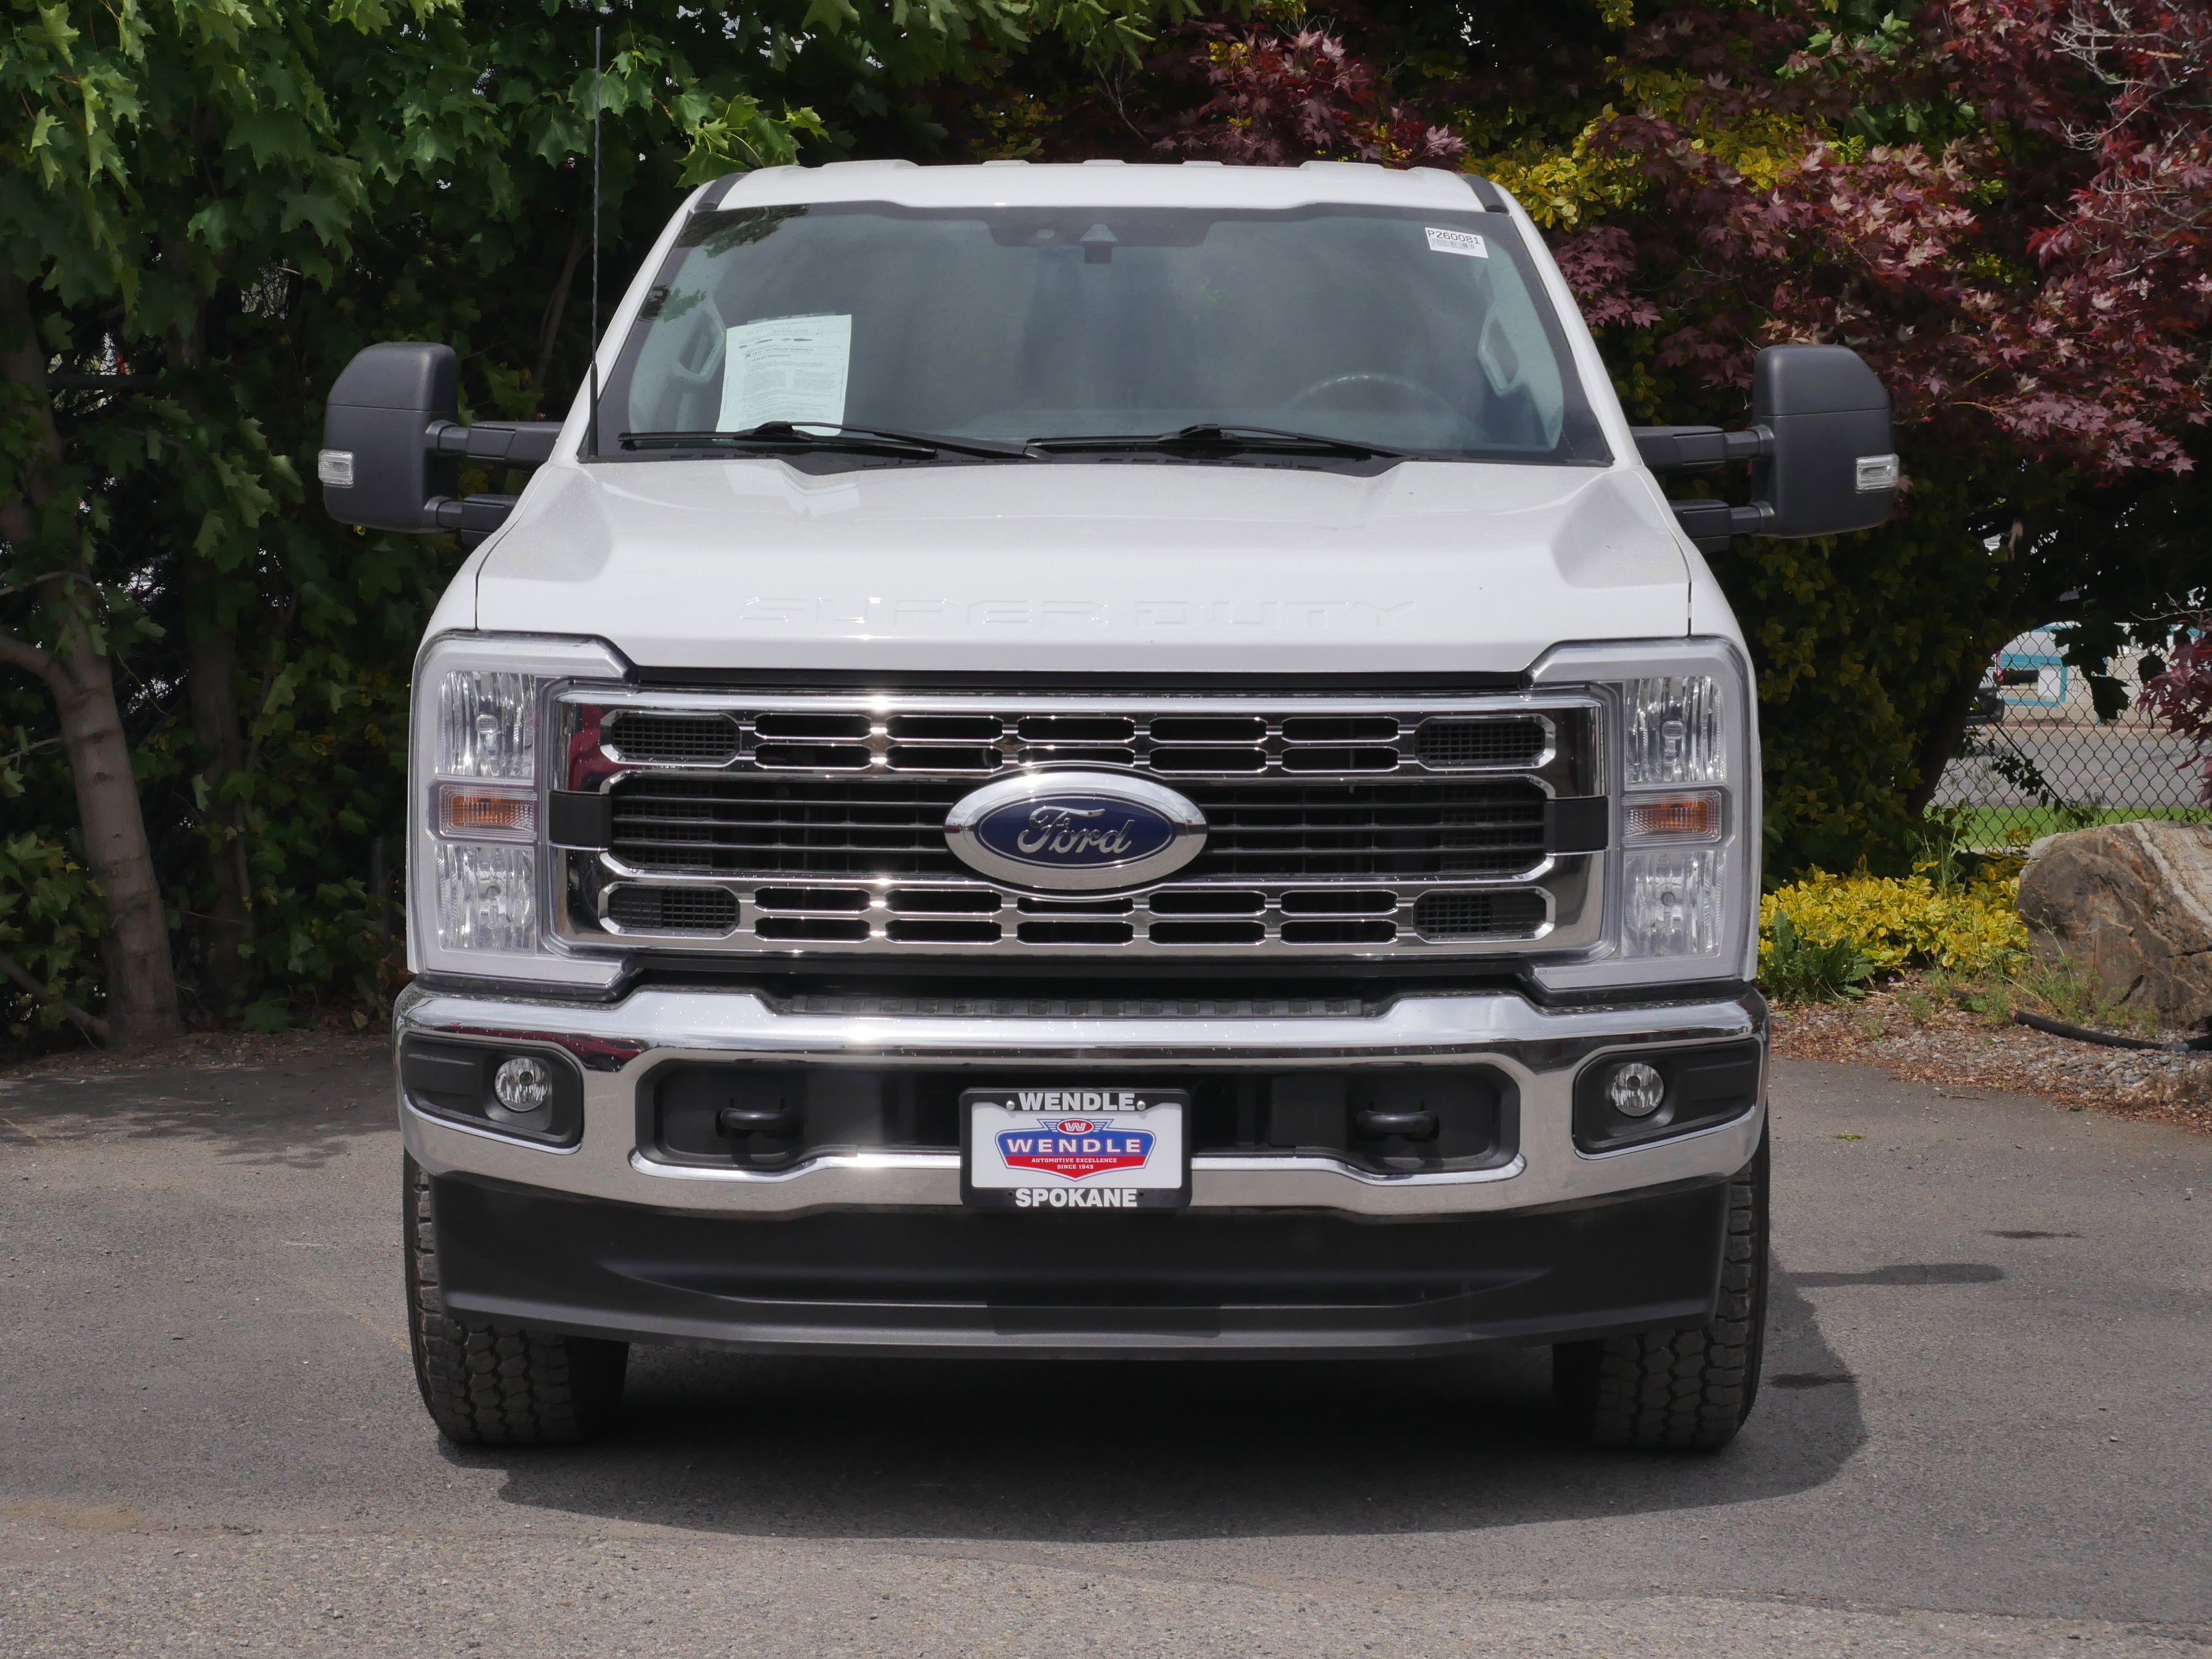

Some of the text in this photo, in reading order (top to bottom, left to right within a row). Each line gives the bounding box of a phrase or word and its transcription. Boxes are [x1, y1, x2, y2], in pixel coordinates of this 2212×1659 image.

[1427, 230, 1480, 245] P260081
[741, 597, 1418, 630] SUPER DUTY
[1017, 806, 1134, 853] Ford
[1018, 1092, 1135, 1111] WENDLE
[1006, 1139, 1142, 1153] WENDLE
[1016, 1188, 1137, 1207] SPOKANE
